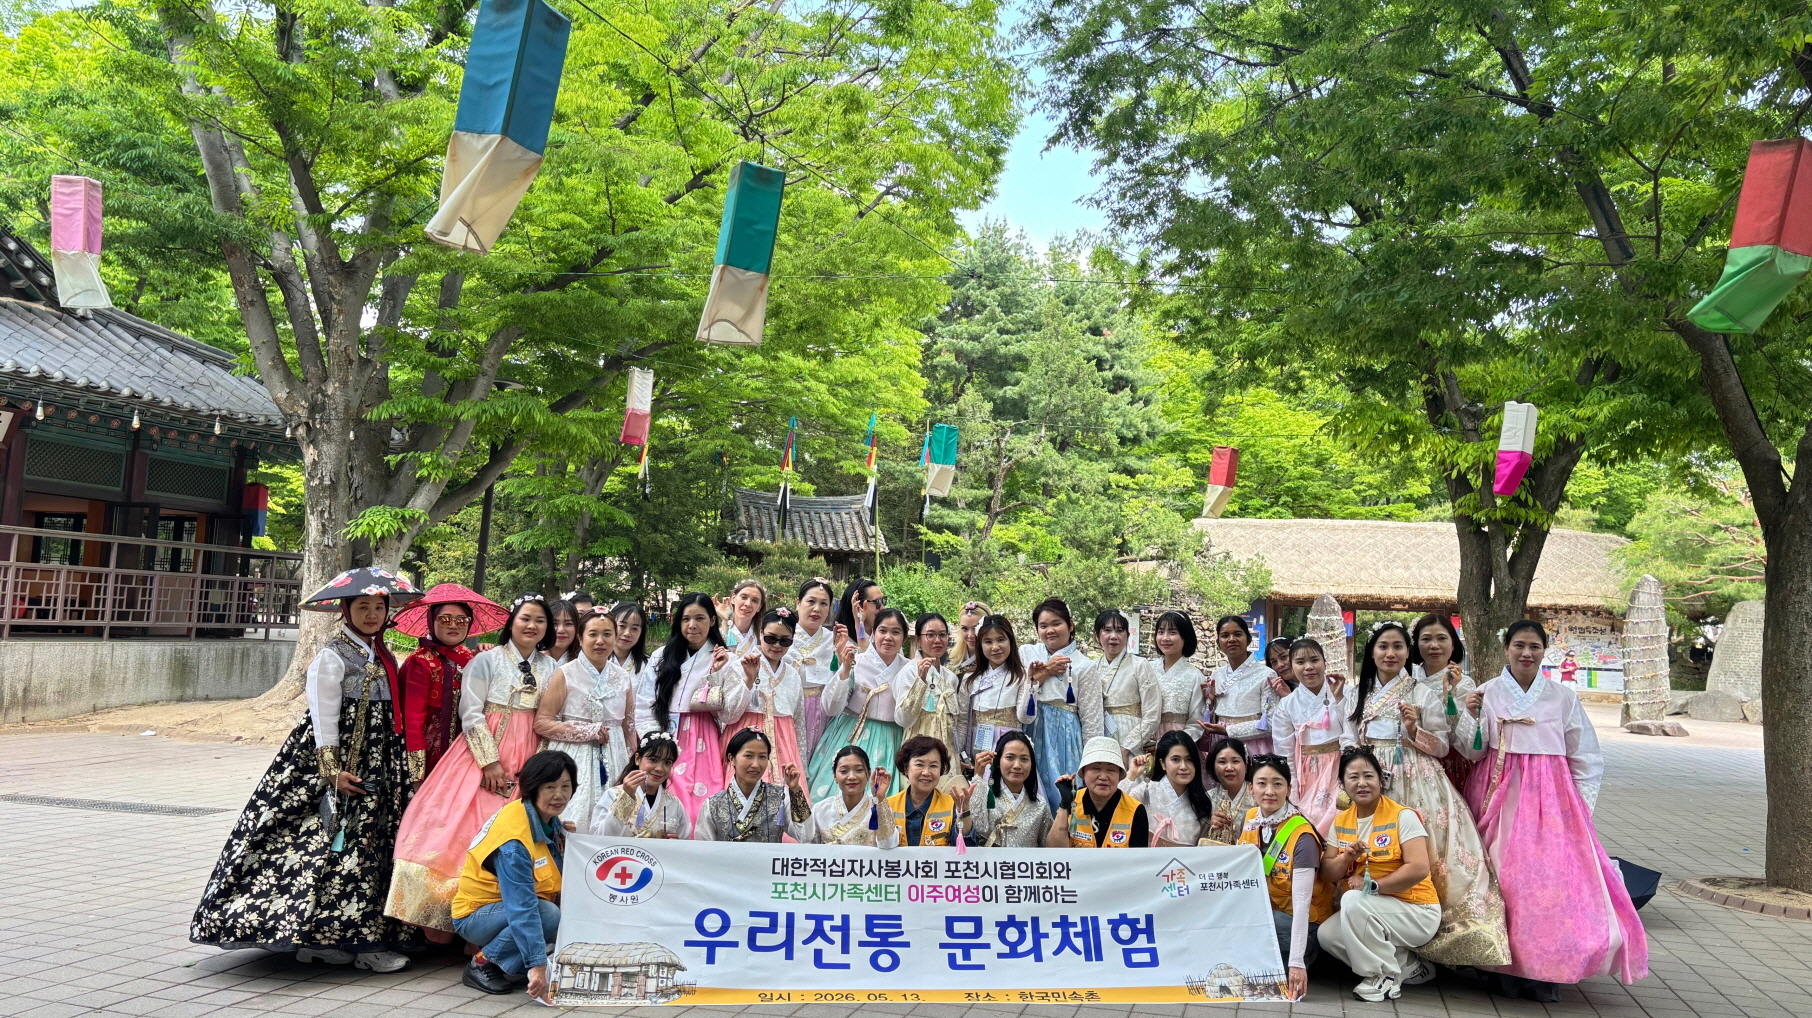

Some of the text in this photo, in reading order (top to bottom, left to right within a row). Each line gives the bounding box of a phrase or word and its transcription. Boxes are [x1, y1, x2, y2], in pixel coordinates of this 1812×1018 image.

[593, 847, 658, 867] KOREAN RED CROSS
[771, 857, 1072, 880] 대한적십자사봉사회 포천시협의회와
[1161, 868, 1186, 886] 가족
[1207, 872, 1215, 880] 큰
[770, 881, 1078, 904] 포천시가족센터 이주여성이 함께하는
[1161, 882, 1190, 899] 센터
[1199, 879, 1260, 892] 포천시가족센터
[683, 907, 1160, 973] 우리전통 문화체험
[757, 992, 792, 1003] 일시
[813, 992, 861, 1002] 2026.
[866, 992, 894, 1002] 05.
[900, 992, 927, 1002] 13.
[964, 991, 999, 1002] 장소
[1017, 990, 1102, 1003] 한국민속촌
